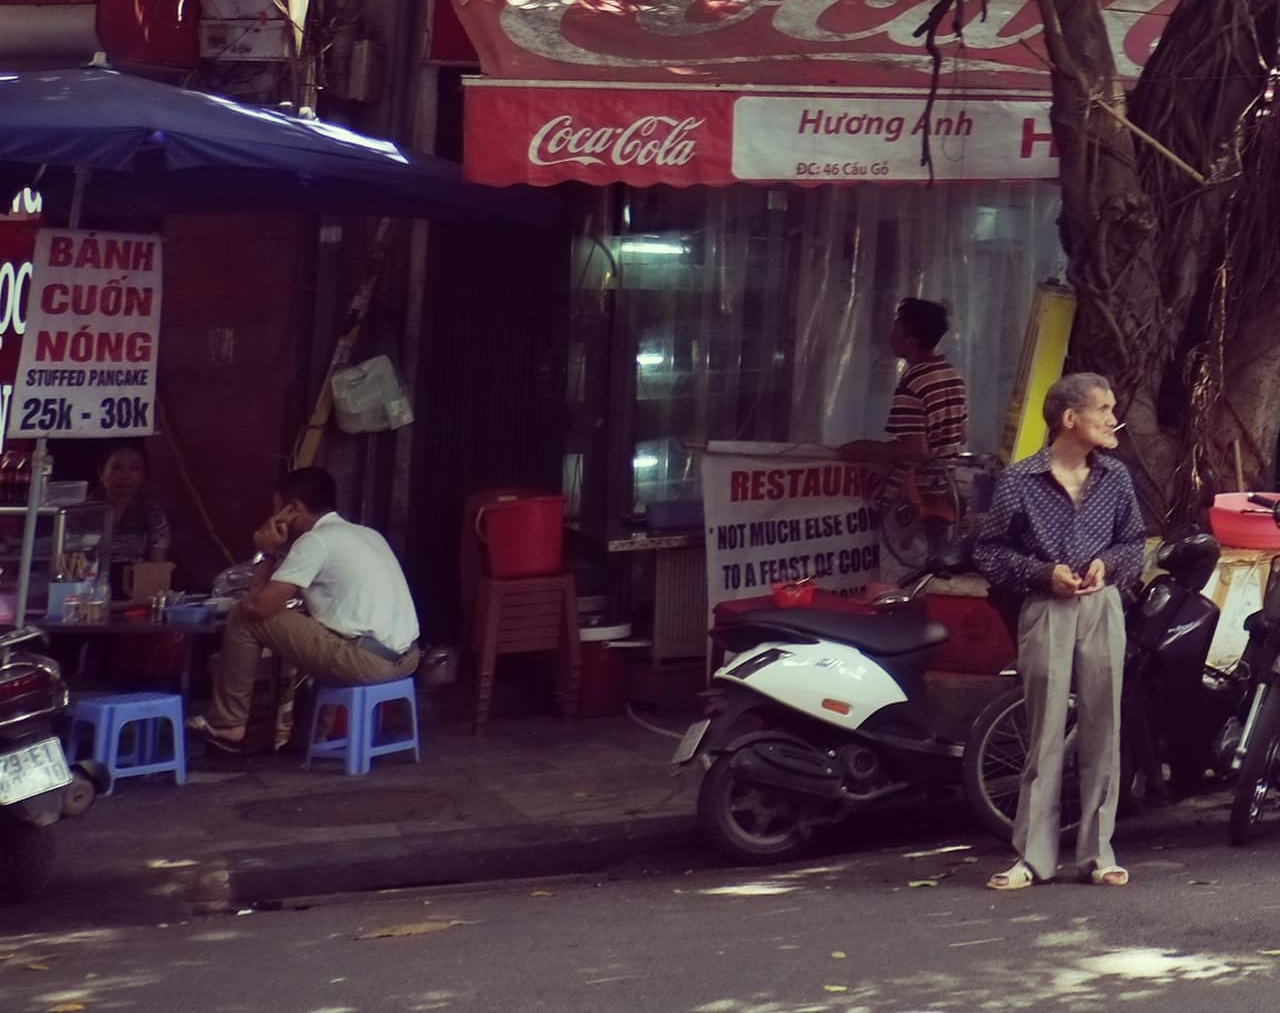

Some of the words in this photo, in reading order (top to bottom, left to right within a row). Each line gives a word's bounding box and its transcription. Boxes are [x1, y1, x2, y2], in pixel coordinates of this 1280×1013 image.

[527, 114, 705, 168] Coca-Cola
[798, 109, 904, 142] Hương
[911, 110, 974, 136] Anh
[823, 163, 840, 176] 46
[48, 232, 155, 272] BÁNH
[40, 275, 154, 317] CUỐN
[34, 325, 152, 363] NÓNG
[26, 369, 85, 387] STUFFED
[90, 369, 149, 387] PANCAKE
[20, 397, 73, 430] 25k
[100, 396, 150, 429] 30k
[750, 519, 800, 548] MUCH
[805, 514, 843, 542] ELSE
[723, 563, 741, 592] TO
[745, 562, 757, 588] A
